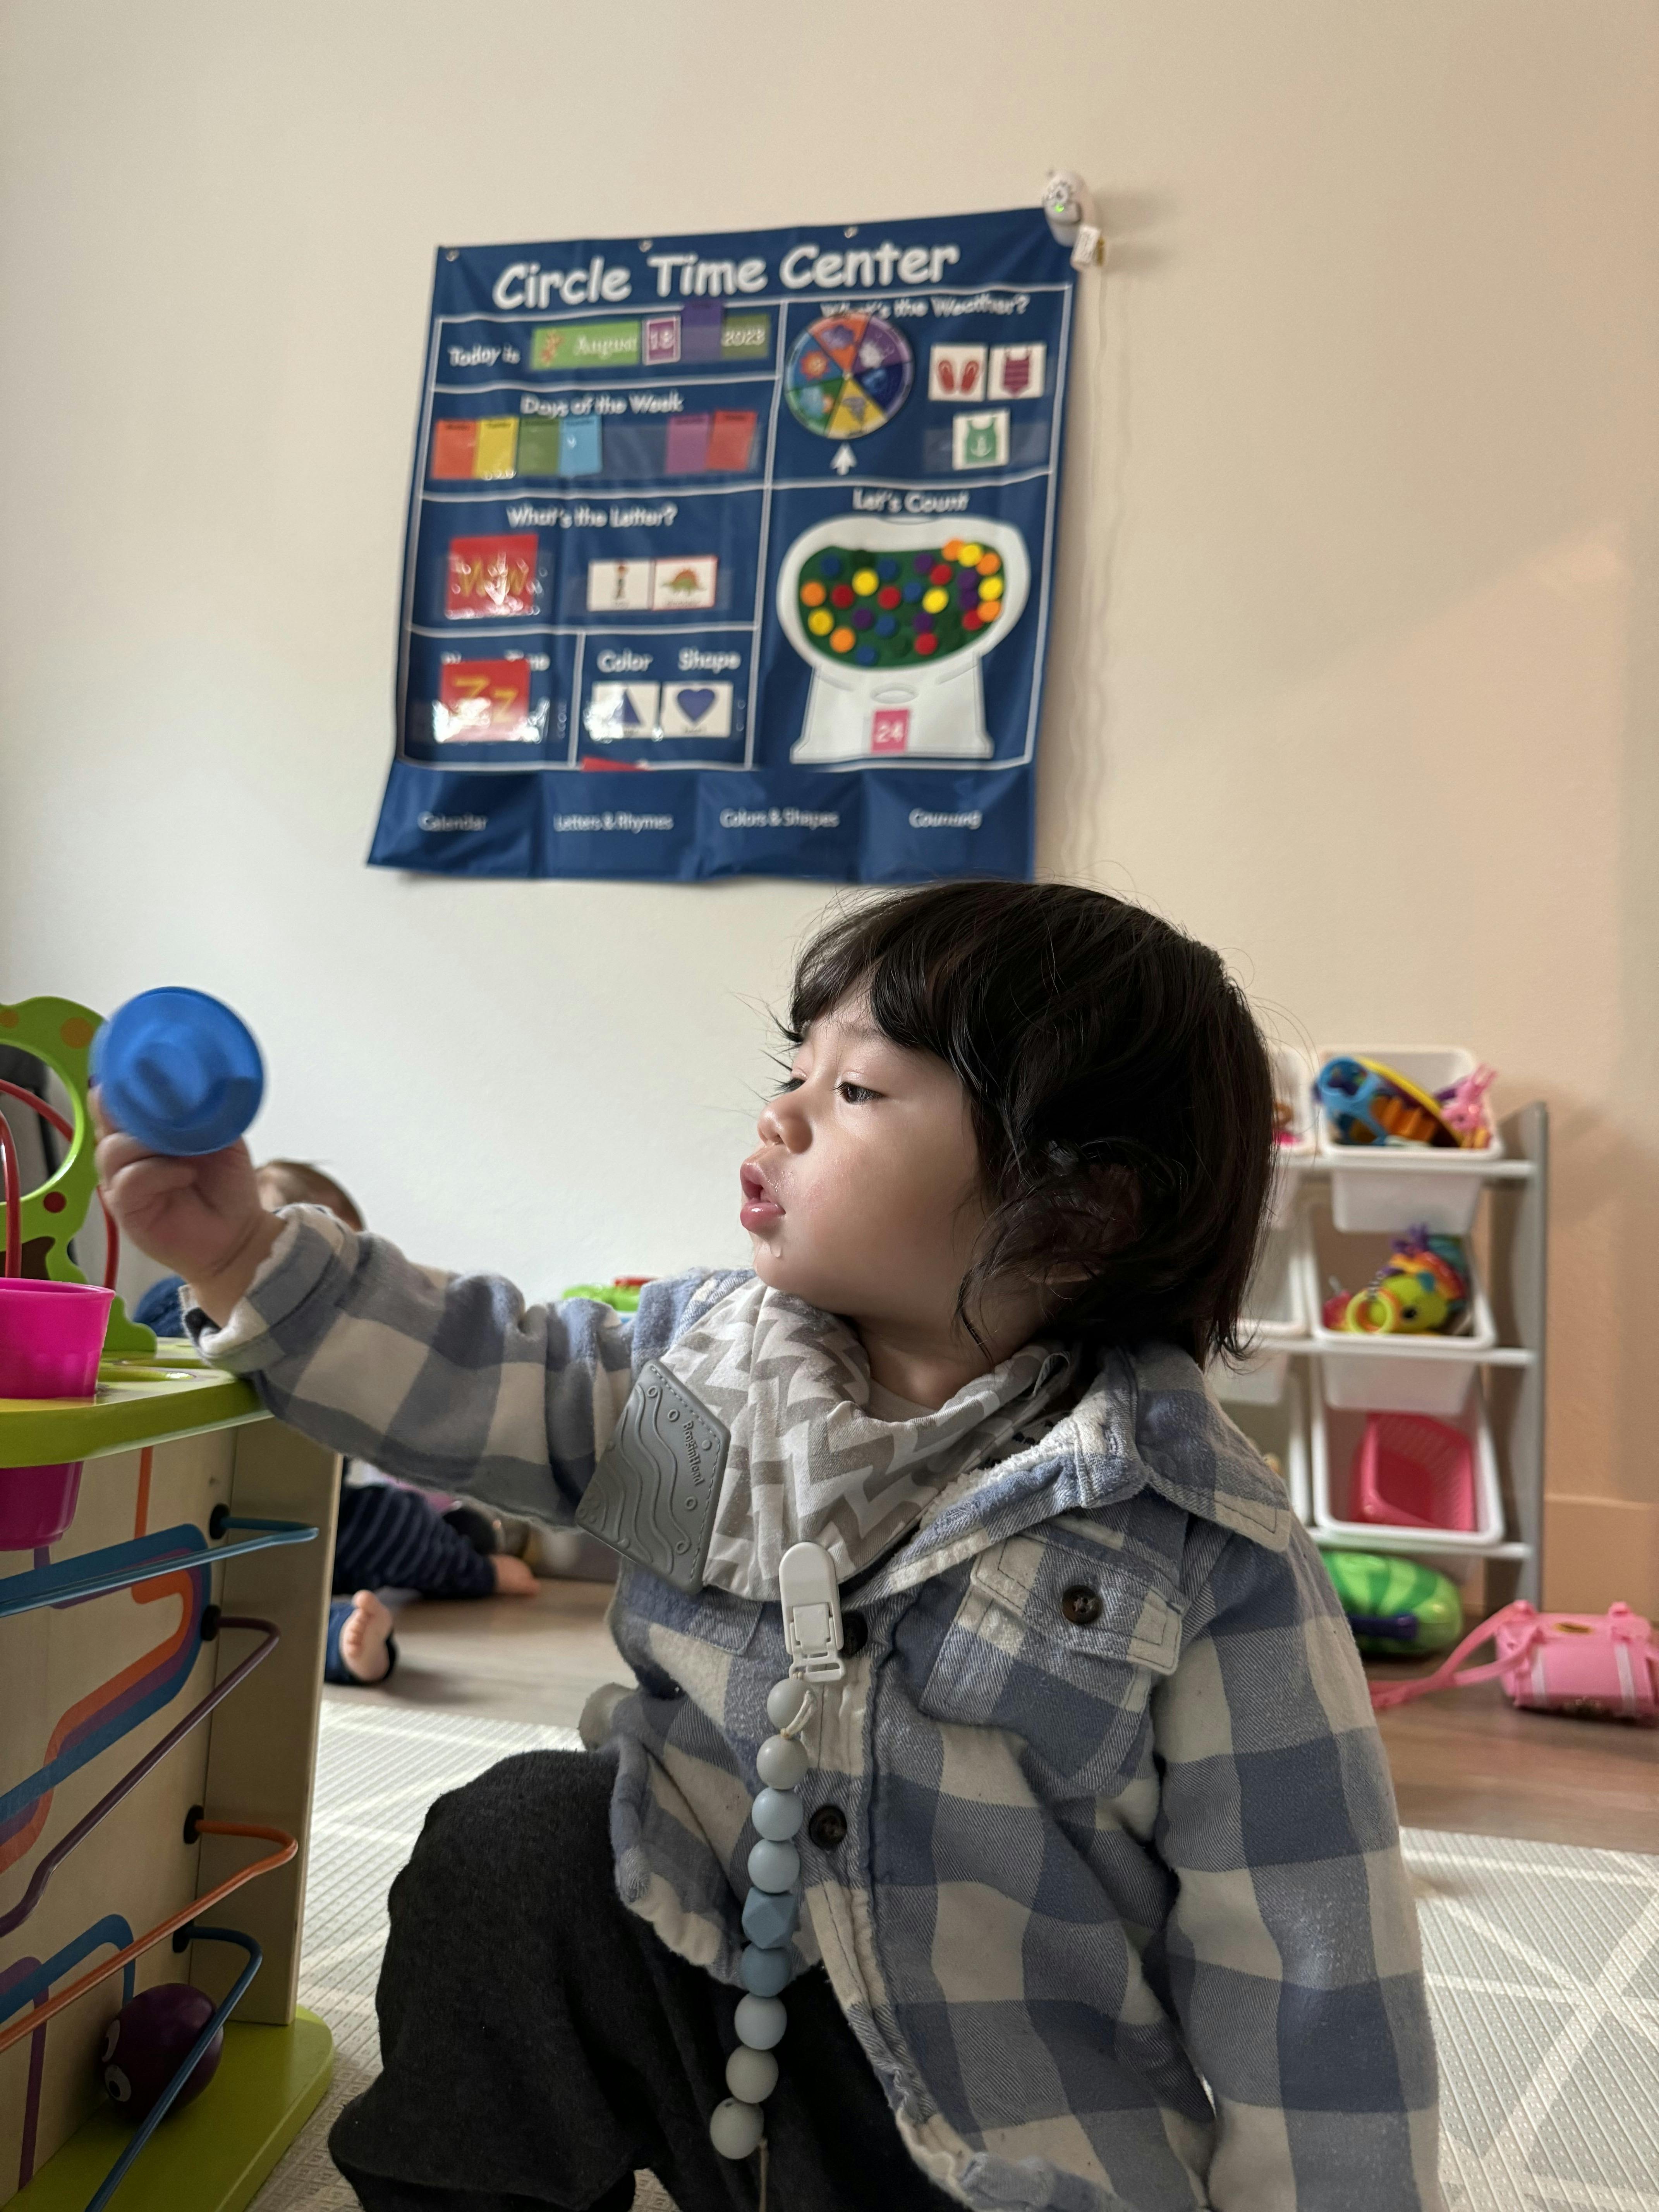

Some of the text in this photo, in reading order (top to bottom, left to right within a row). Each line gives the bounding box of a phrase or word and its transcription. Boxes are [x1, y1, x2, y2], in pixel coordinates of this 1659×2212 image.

[493, 243, 960, 309] Circle Time Center
[894, 299, 929, 318] the
[932, 294, 1030, 317] Weather?
[449, 342, 521, 366] Today is
[576, 334, 637, 358] August
[521, 389, 685, 417] Days of the Week
[853, 490, 969, 512] Let's Count
[508, 503, 678, 529] What's the Letter?
[599, 650, 652, 671] Color
[680, 648, 740, 673] Shape
[876, 723, 903, 744] 24
[418, 811, 488, 831] Calendar
[553, 813, 602, 832] Letters
[720, 808, 768, 828] Colors
[782, 807, 840, 830] Shapes
